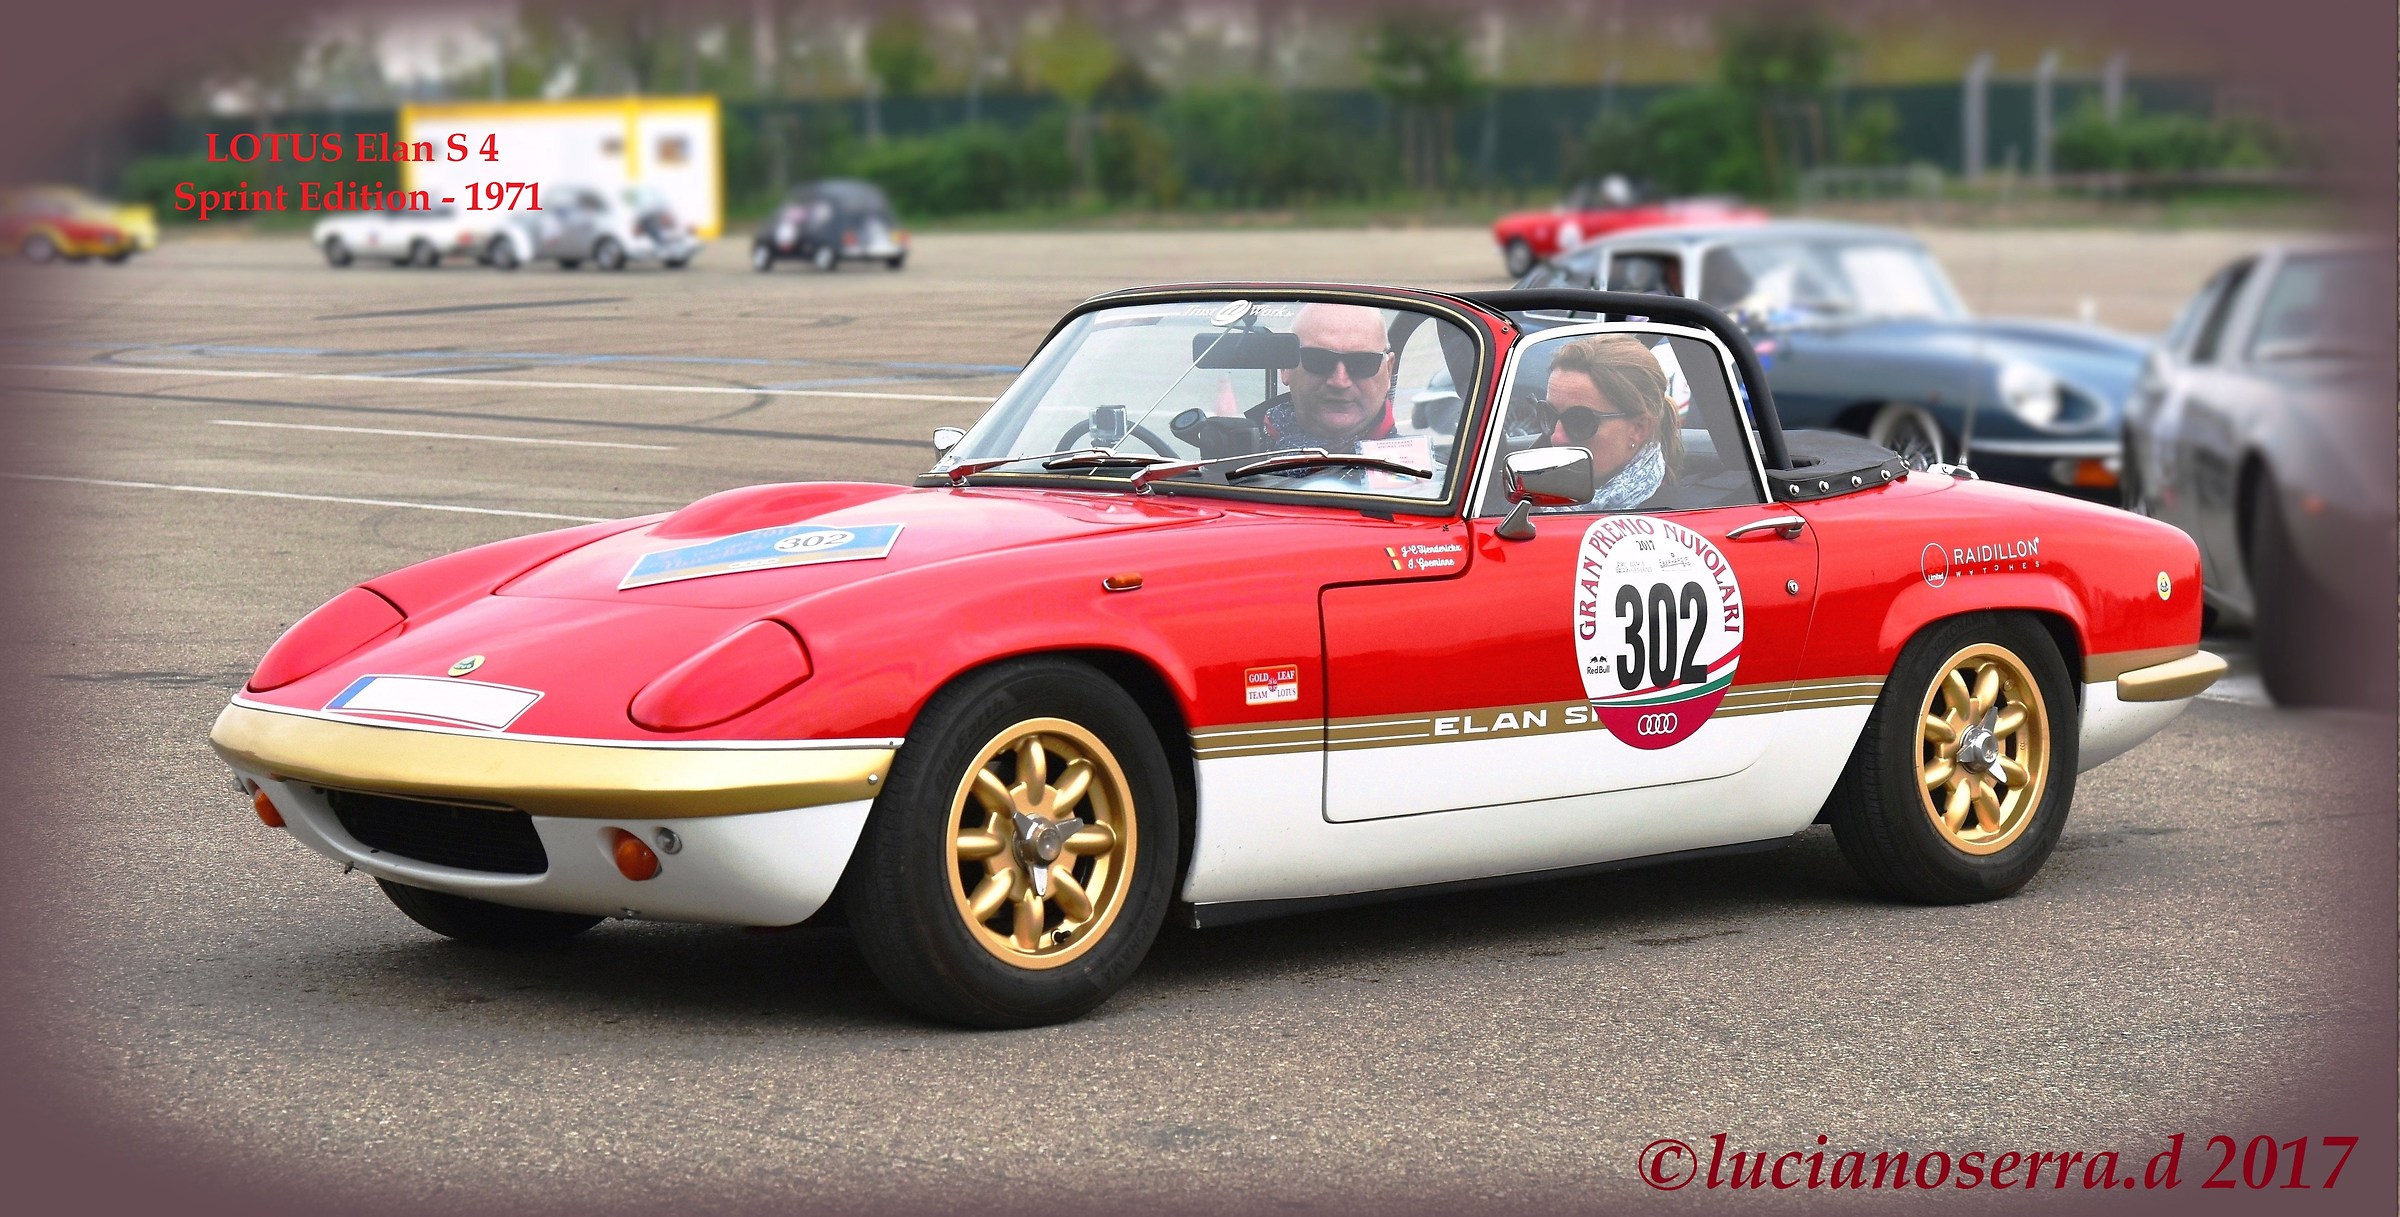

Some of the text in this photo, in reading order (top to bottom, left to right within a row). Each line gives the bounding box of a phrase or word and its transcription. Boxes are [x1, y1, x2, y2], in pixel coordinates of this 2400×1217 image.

[778, 533, 848, 550] 302
[1636, 540, 1656, 551] 2017
[1579, 518, 1740, 641] GRAN PREMIO NUVOLARI
[1615, 581, 1708, 691] 302
[1249, 670, 1295, 683] GOLD LEAF
[1249, 688, 1296, 700] TEAM LOTUS
[1434, 709, 1547, 736] ELAN
